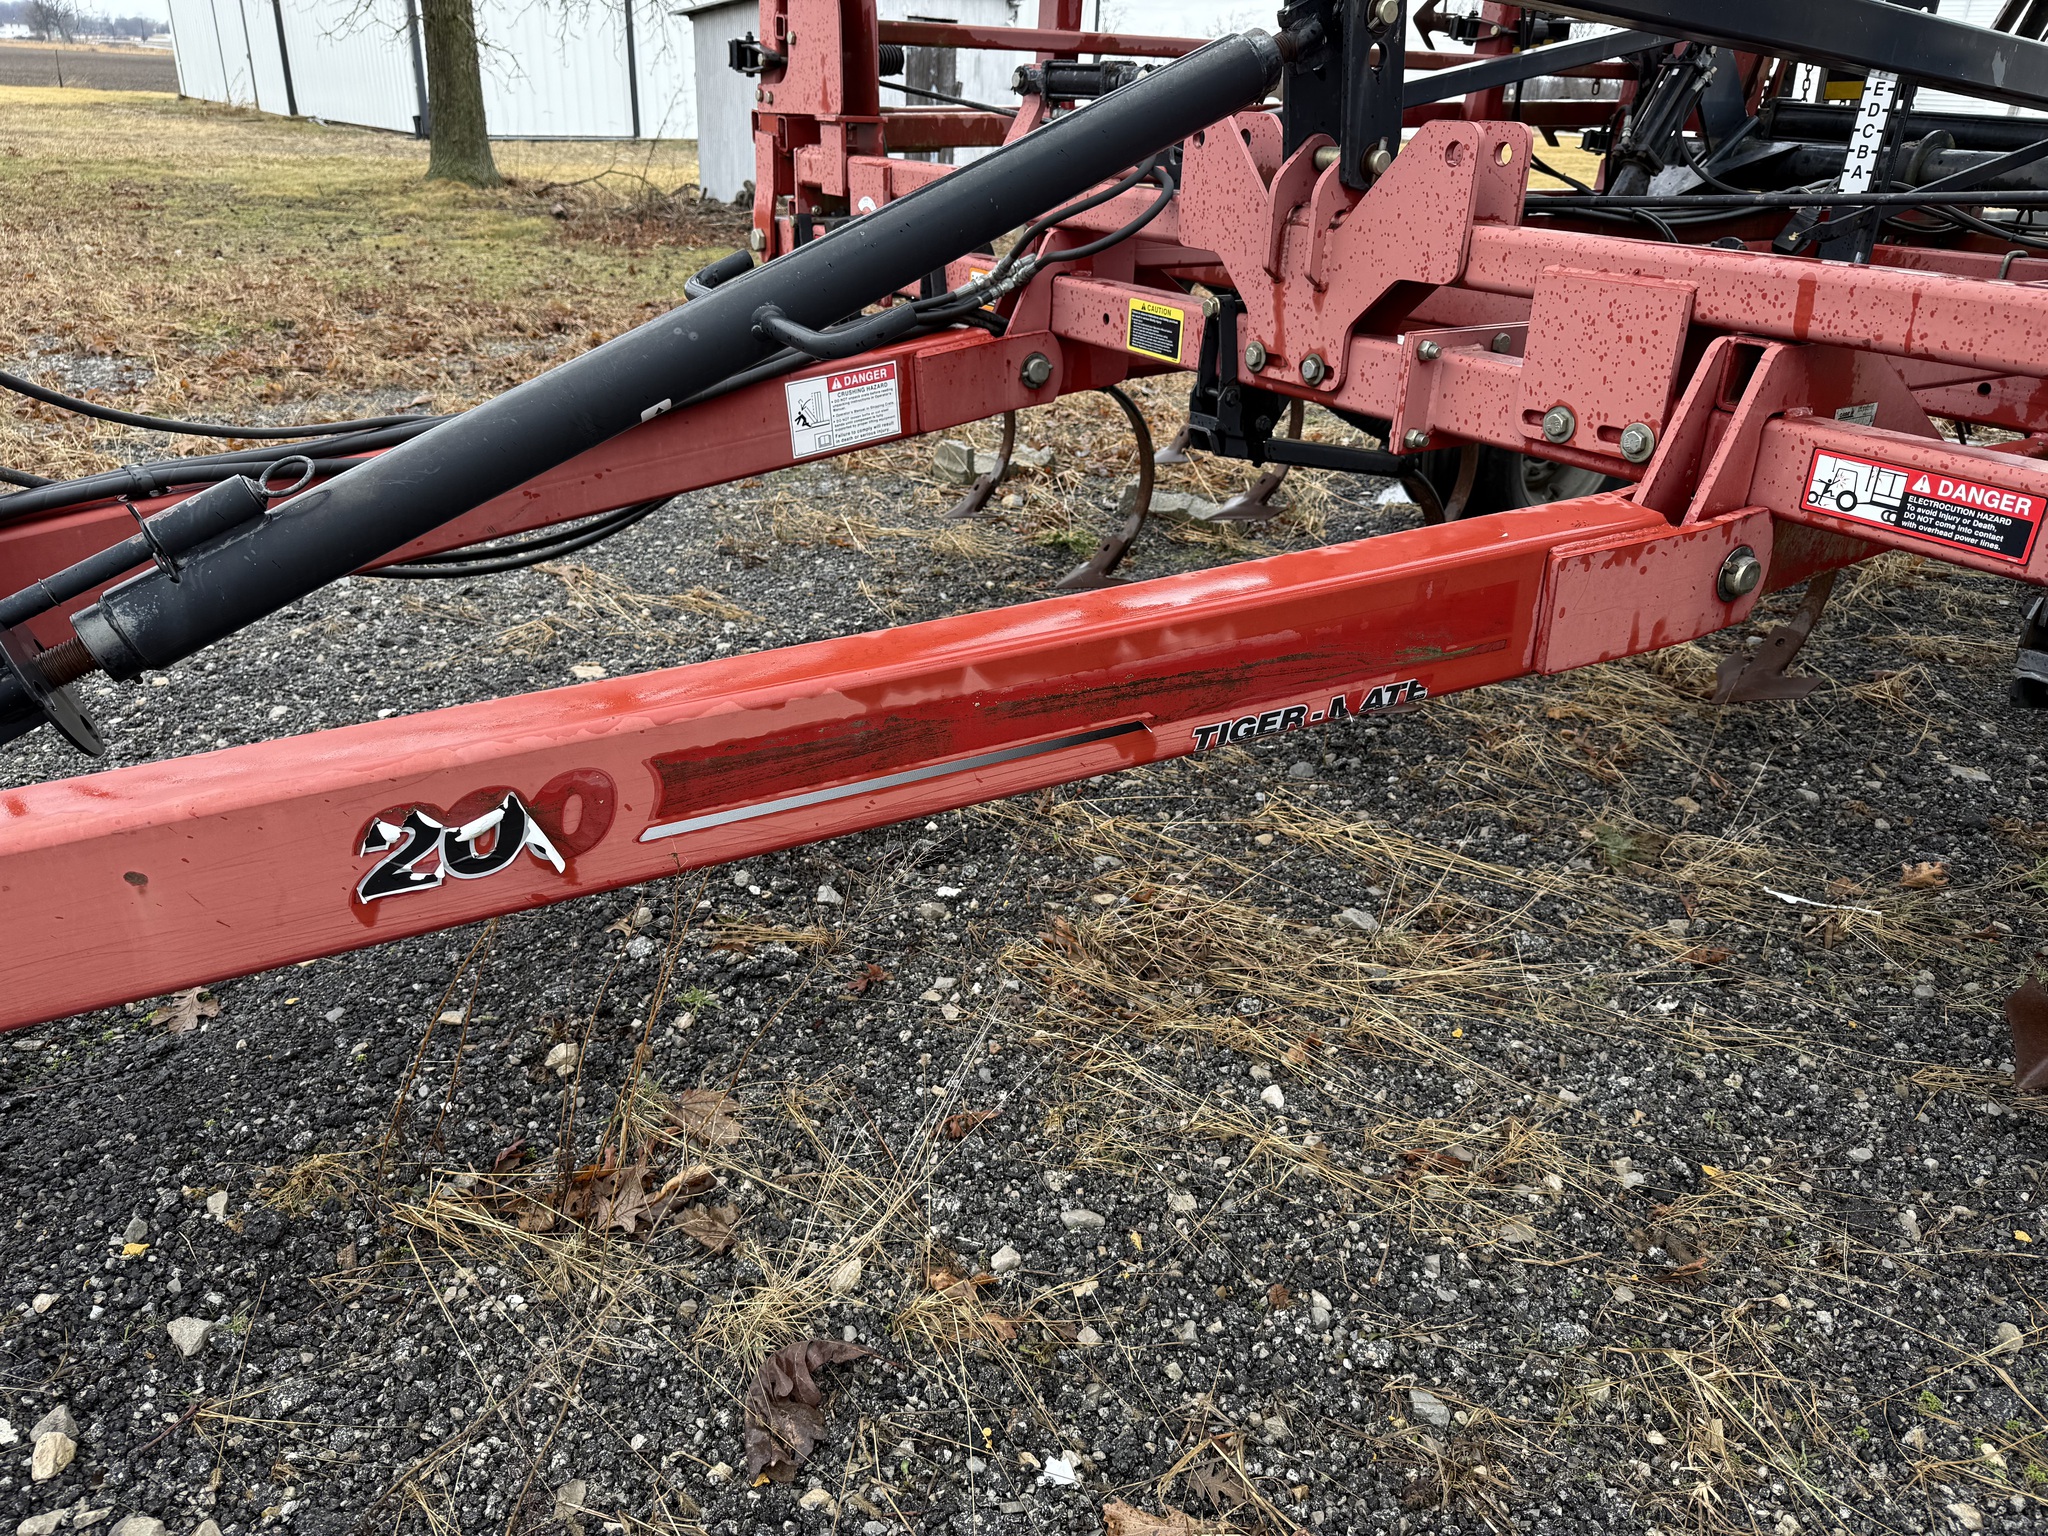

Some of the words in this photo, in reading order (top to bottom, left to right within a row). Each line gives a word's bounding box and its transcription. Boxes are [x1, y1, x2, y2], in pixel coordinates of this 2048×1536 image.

[1874, 82, 1886, 96] E
[1868, 103, 1880, 116] D
[1863, 124, 1875, 138] C
[1857, 145, 1868, 158] B
[1851, 165, 1862, 179] A
[1147, 304, 1171, 316] CAUTION
[844, 368, 887, 386] DANGER
[837, 387, 865, 398] CRUSHING
[1937, 480, 2032, 516] DANGER
[1907, 503, 1915, 511] To
[1916, 507, 1938, 517] avoid
[1972, 519, 1997, 532] Death,
[1908, 495, 1975, 517] ELECTROCUTION
[1977, 512, 2012, 526] HAZARD
[1904, 511, 1916, 520] DO
[1917, 515, 1934, 524] NOT
[1935, 520, 1956, 530] come
[1957, 525, 1973, 534] into
[1974, 530, 2004, 542] contact
[1902, 521, 1917, 529] with
[1918, 525, 1953, 538] overhead
[1954, 534, 1979, 544] power
[1980, 539, 2000, 550] lines.
